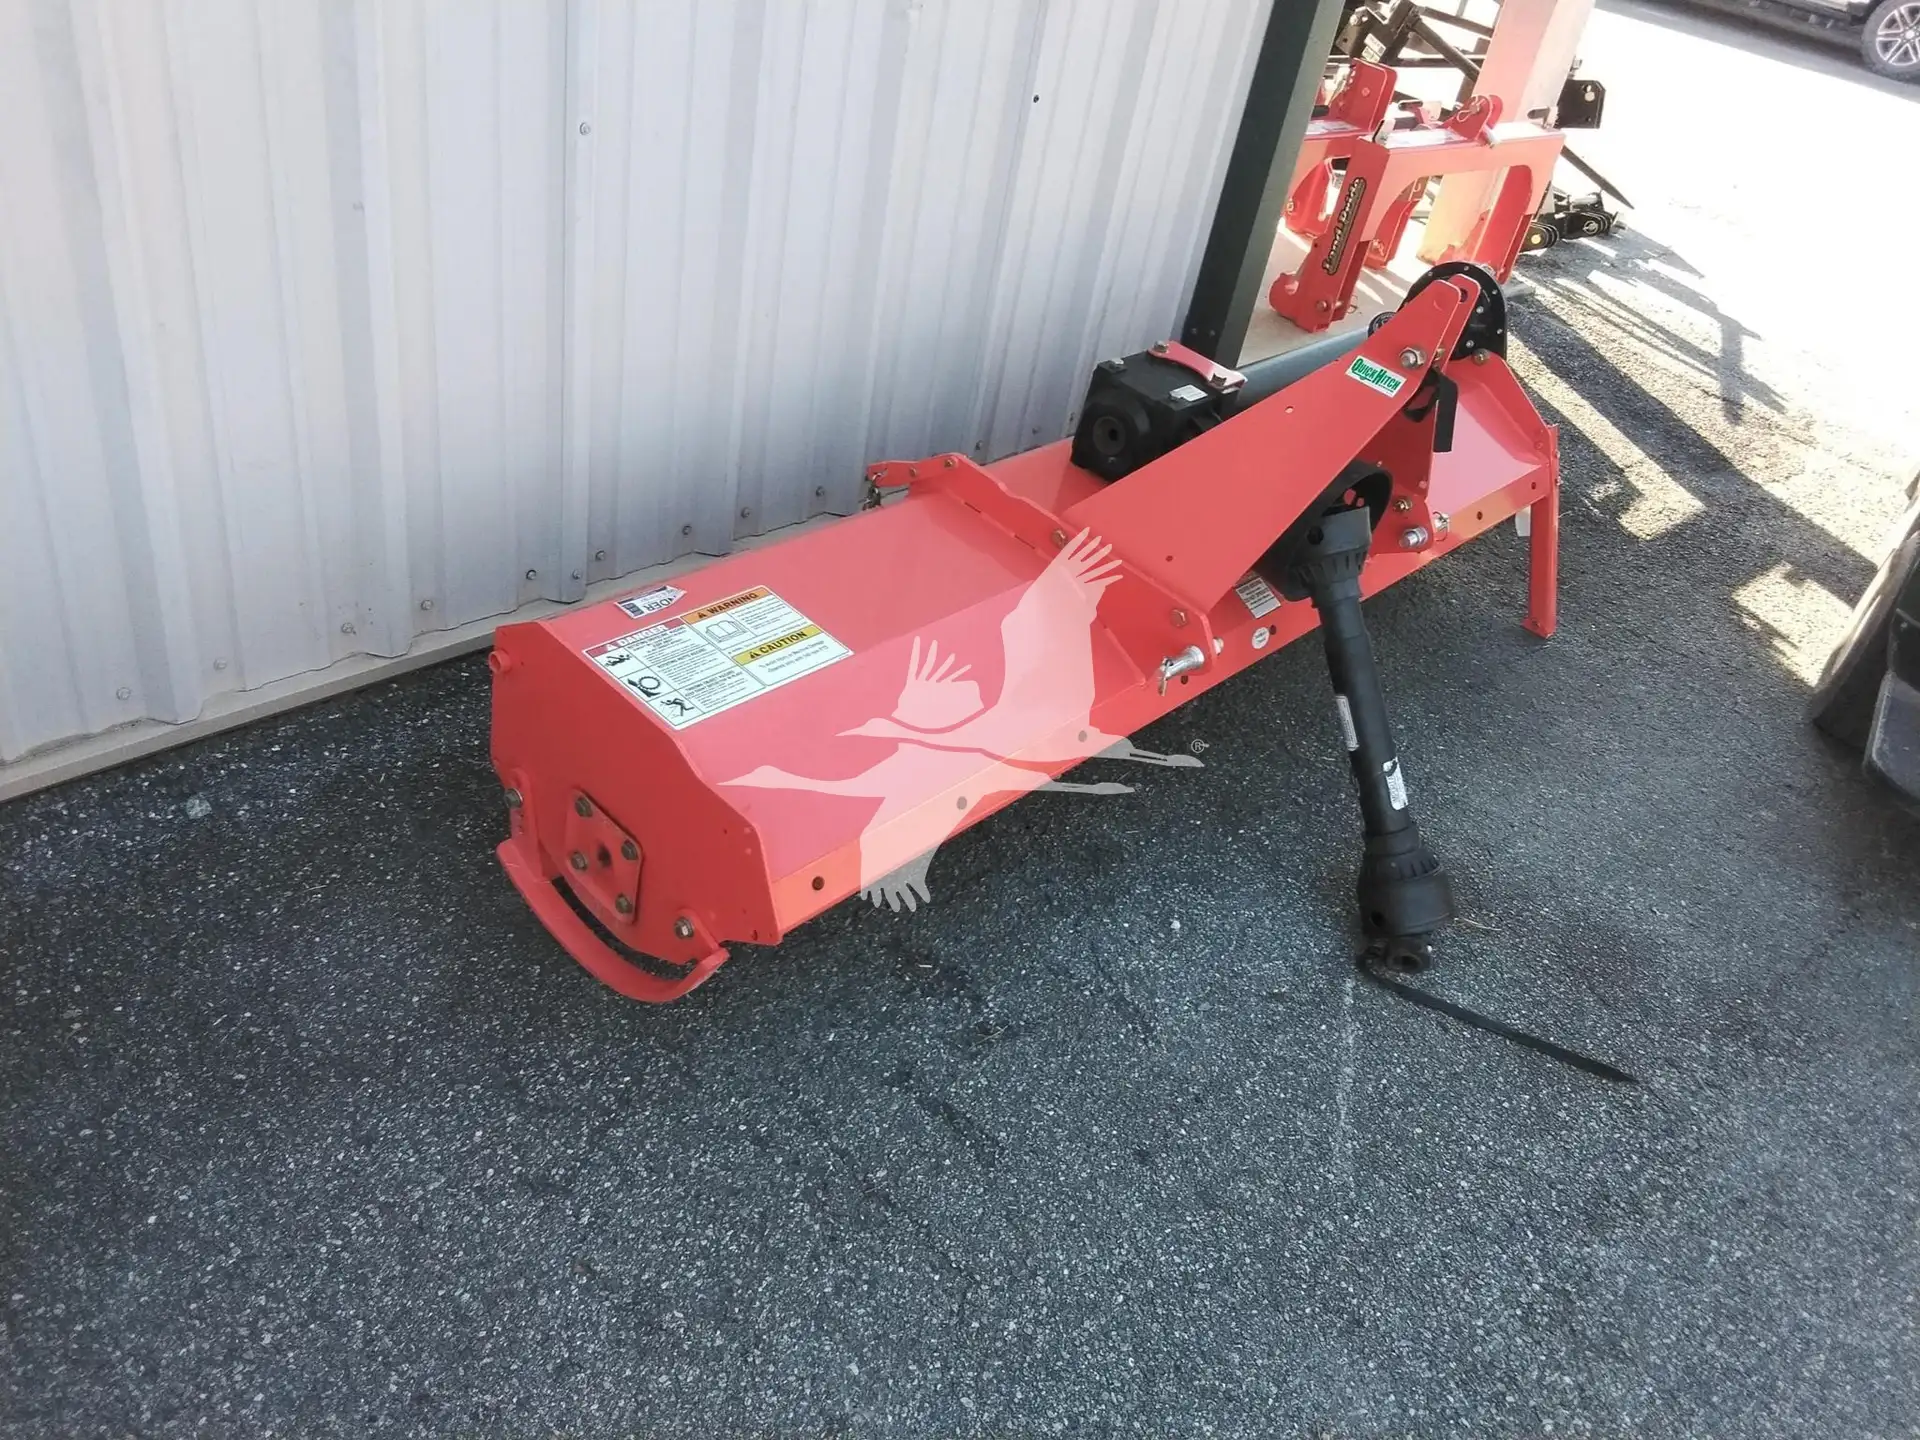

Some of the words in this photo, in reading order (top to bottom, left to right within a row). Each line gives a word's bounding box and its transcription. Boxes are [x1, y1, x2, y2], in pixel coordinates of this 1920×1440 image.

[706, 592, 759, 615] WARNING
[618, 624, 669, 646] DANGER
[758, 631, 808, 654] CAUTION
